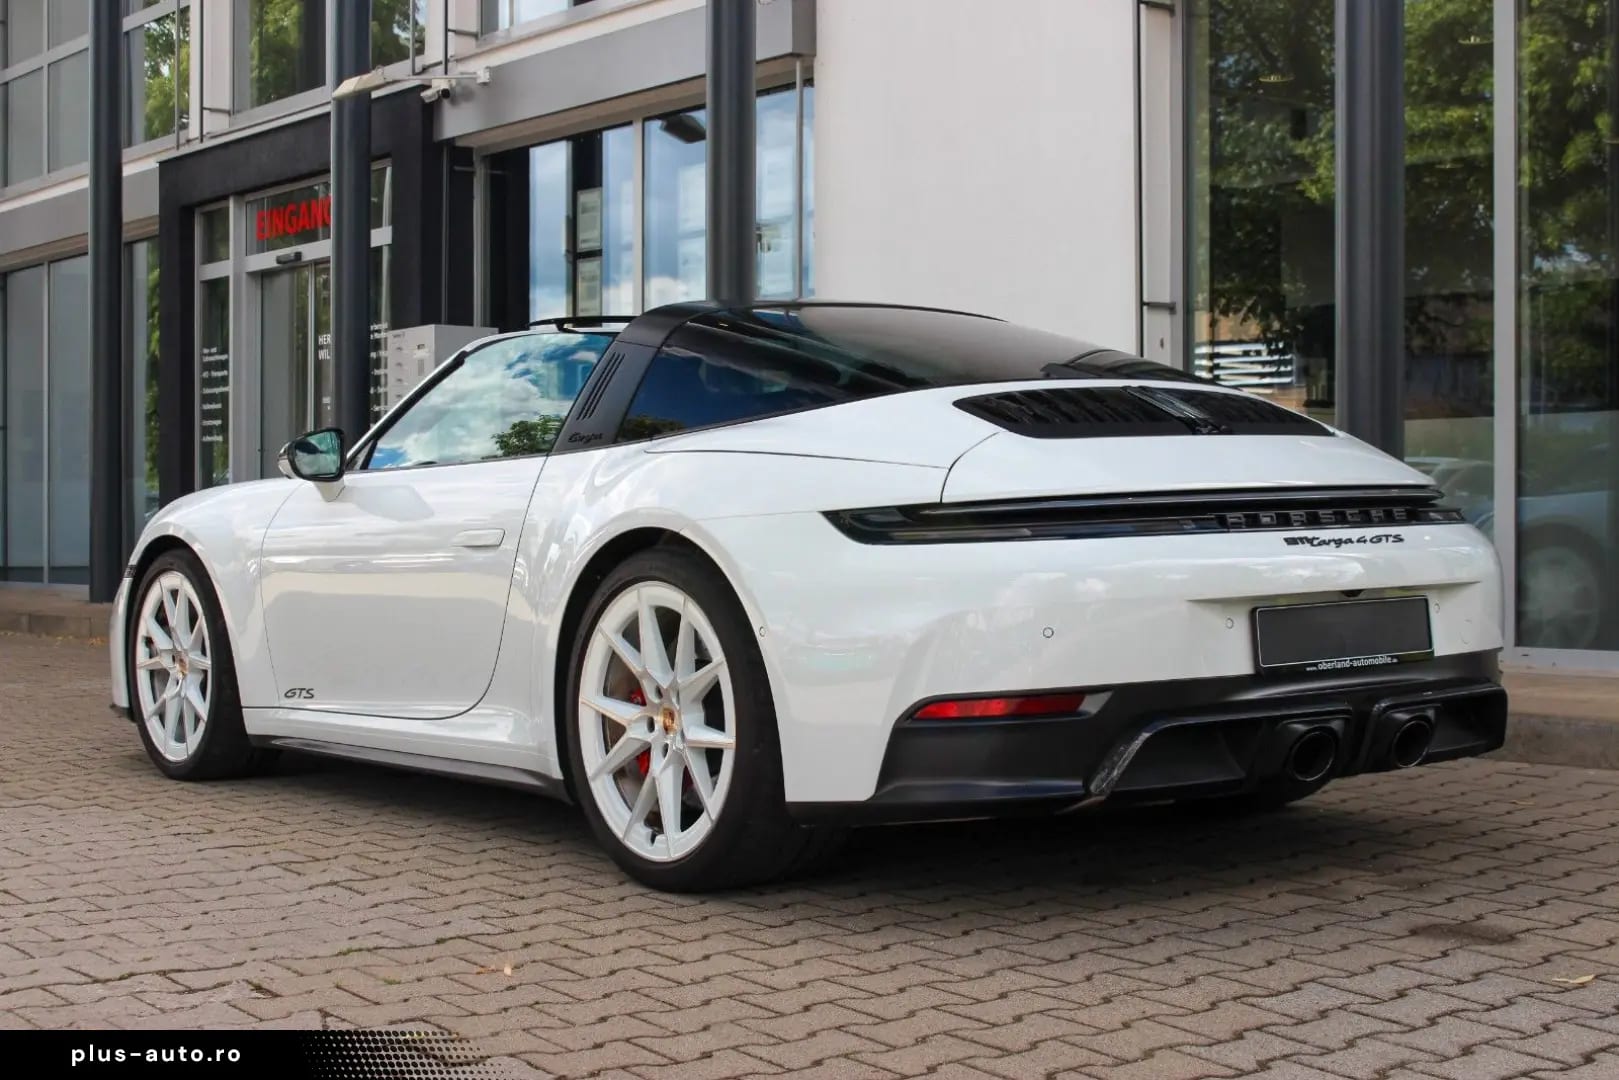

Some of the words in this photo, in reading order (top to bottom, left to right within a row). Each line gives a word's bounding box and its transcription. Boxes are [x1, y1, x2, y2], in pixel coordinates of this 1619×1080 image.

[1226, 508, 1408, 527] PORSCHE
[1356, 535, 1368, 544] 4
[1369, 534, 1405, 544] GTS
[284, 687, 315, 699] GTS
